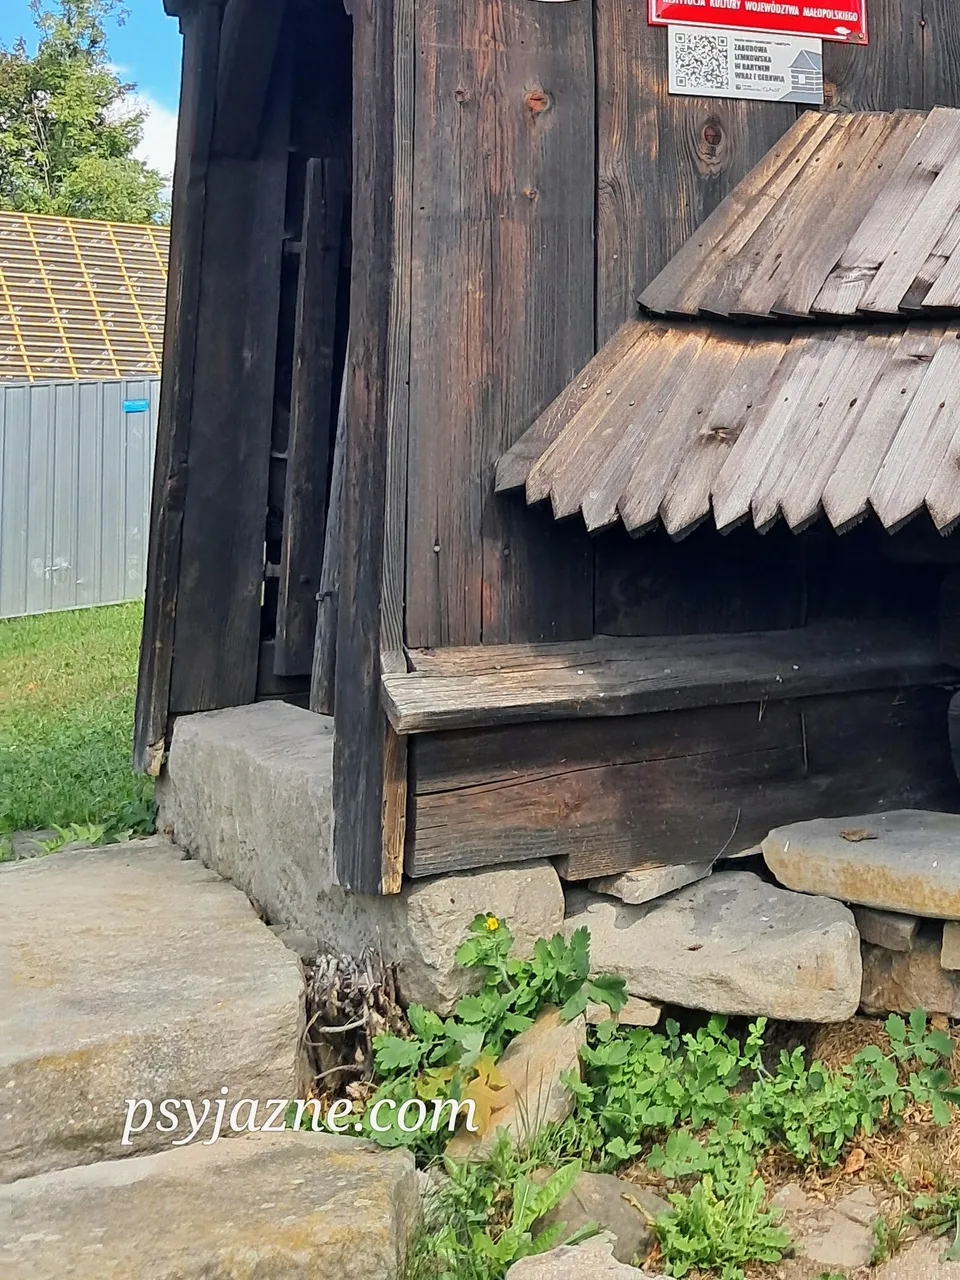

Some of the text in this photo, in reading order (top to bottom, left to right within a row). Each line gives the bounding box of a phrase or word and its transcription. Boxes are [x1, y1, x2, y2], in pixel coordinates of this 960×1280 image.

[744, 0, 800, 16] WOJEWÓDZTWA
[802, 6, 859, 22] MAŁOPOLSKIEGO
[734, 44, 768, 53] ZABUDOWA
[742, 63, 770, 71] BARTNEM
[734, 72, 753, 80] WRAZ
